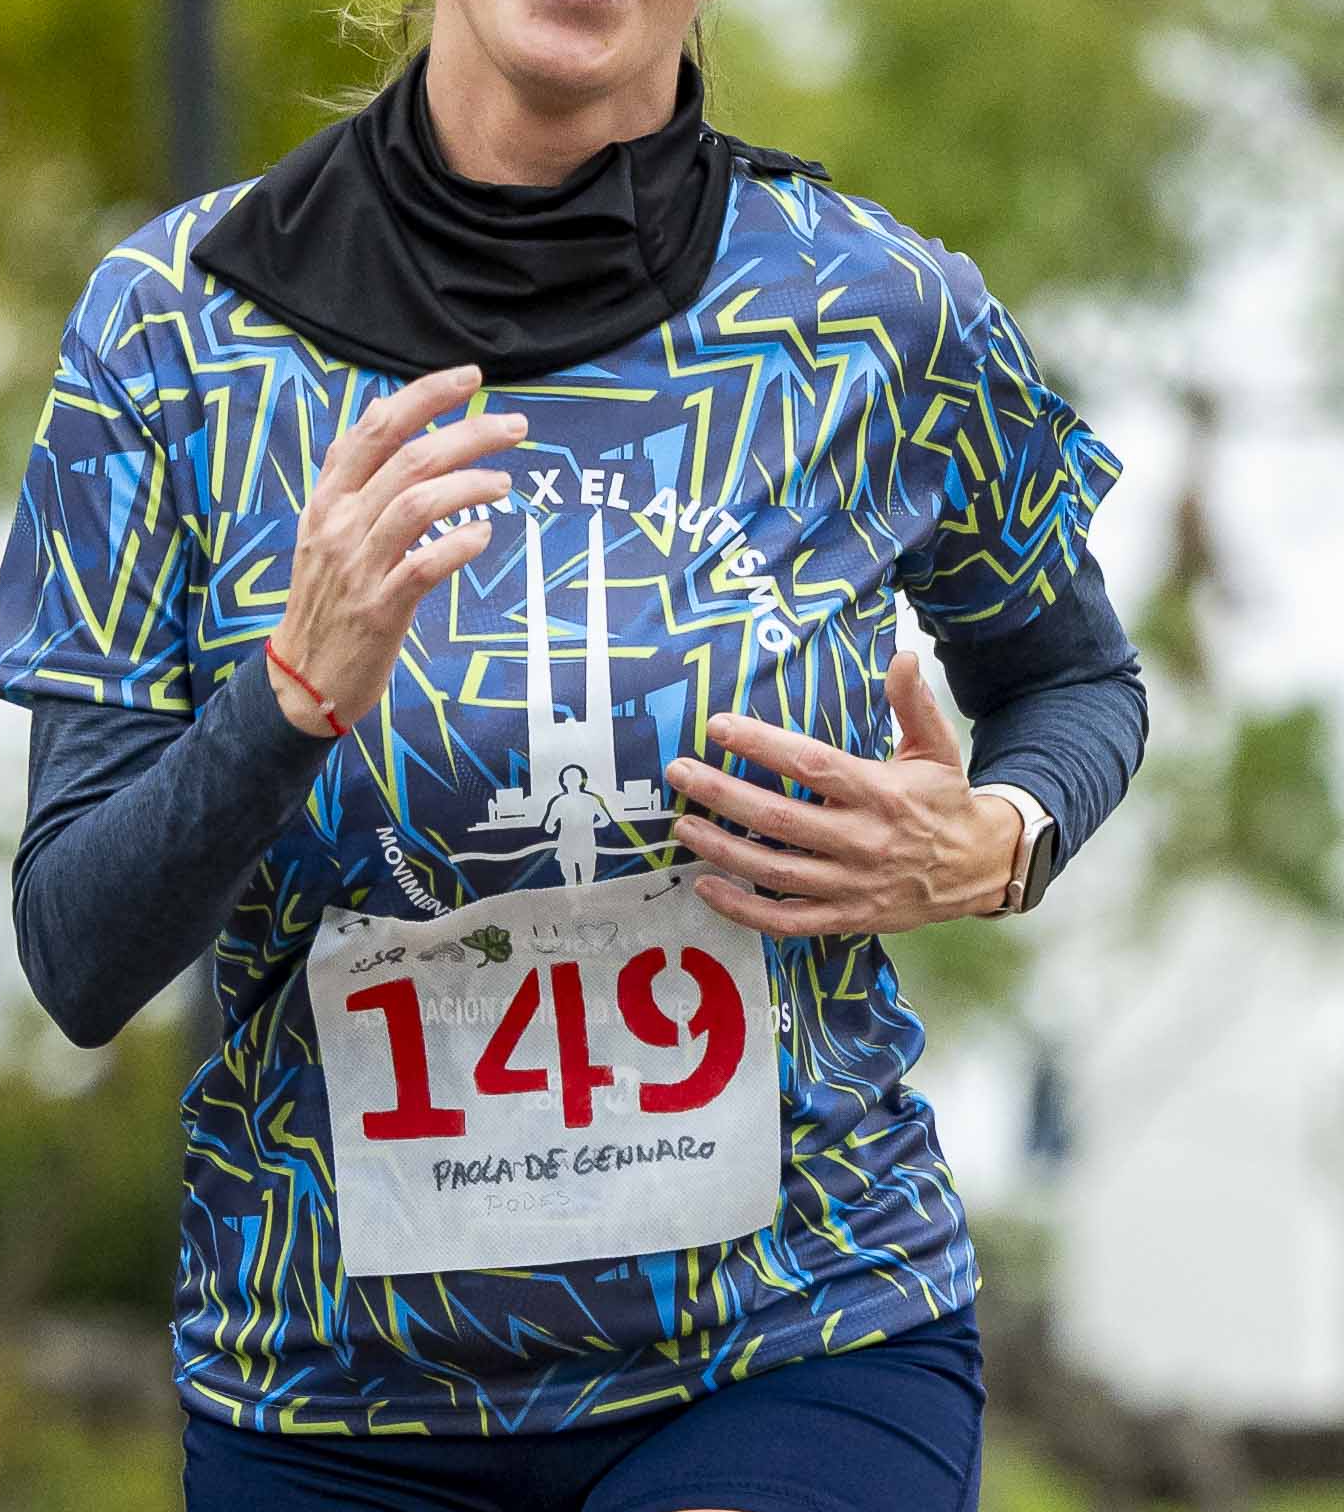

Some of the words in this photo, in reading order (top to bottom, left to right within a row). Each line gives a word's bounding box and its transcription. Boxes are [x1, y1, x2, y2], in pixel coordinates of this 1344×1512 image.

[528, 468, 564, 506] X
[581, 468, 630, 511] EL
[640, 486, 793, 653] AUTISMO
[375, 826, 454, 917] MOVIMIEN
[346, 945, 747, 1141] 149
[432, 1155, 514, 1191] PAOLA
[524, 1147, 567, 1181] DE
[572, 1135, 717, 1176] GENNARO
